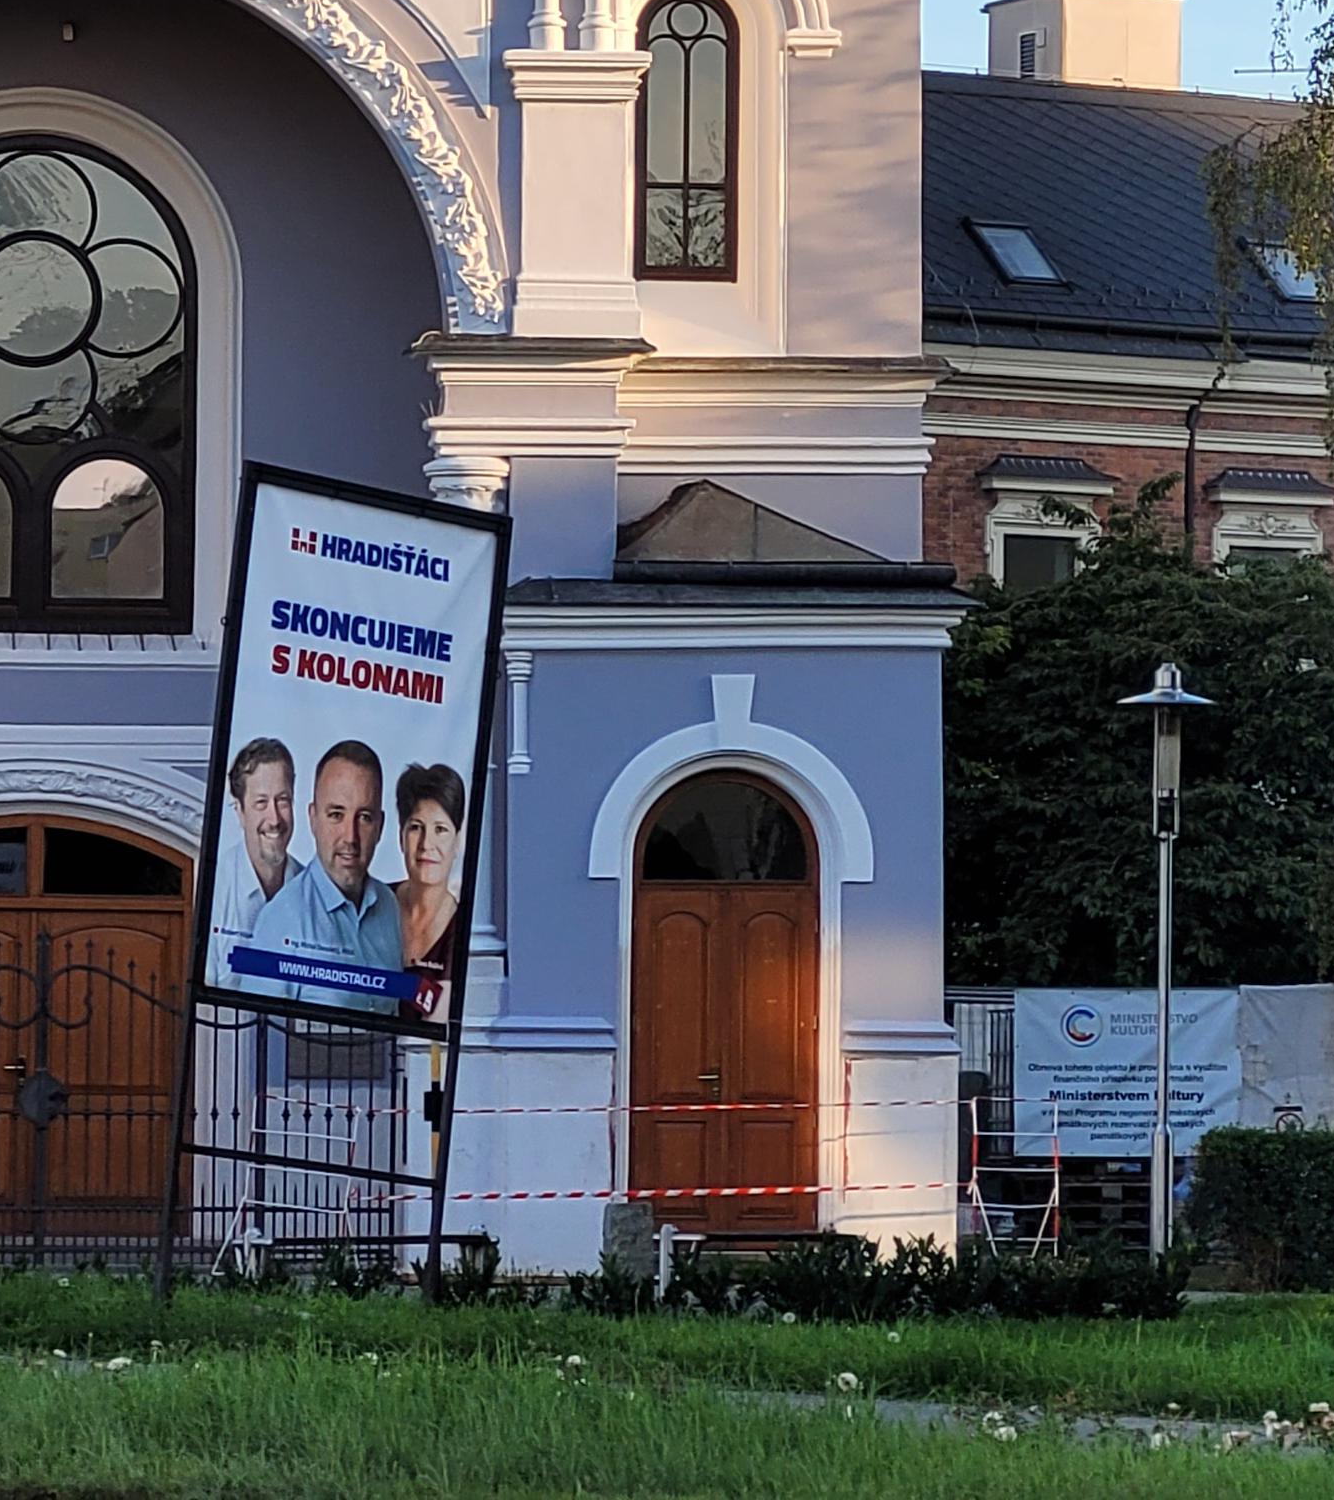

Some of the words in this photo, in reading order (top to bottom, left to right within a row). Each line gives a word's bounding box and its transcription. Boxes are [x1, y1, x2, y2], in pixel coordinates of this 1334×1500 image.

[320, 533, 450, 582] HRADIŠŤÁCI
[271, 599, 454, 663] SKONCUJEME
[271, 644, 292, 675] S
[286, 648, 445, 705] KOLONAMI
[278, 960, 387, 990] WWW.HRADISTACI.CZ
[1110, 1013, 1199, 1025] MINISTESTVO
[1110, 1024, 1159, 1036] KULTUR
[1049, 1089, 1150, 1101] Ministerstvem
[1153, 1088, 1205, 1104] ltury
[1118, 1109, 1159, 1119] regenera
